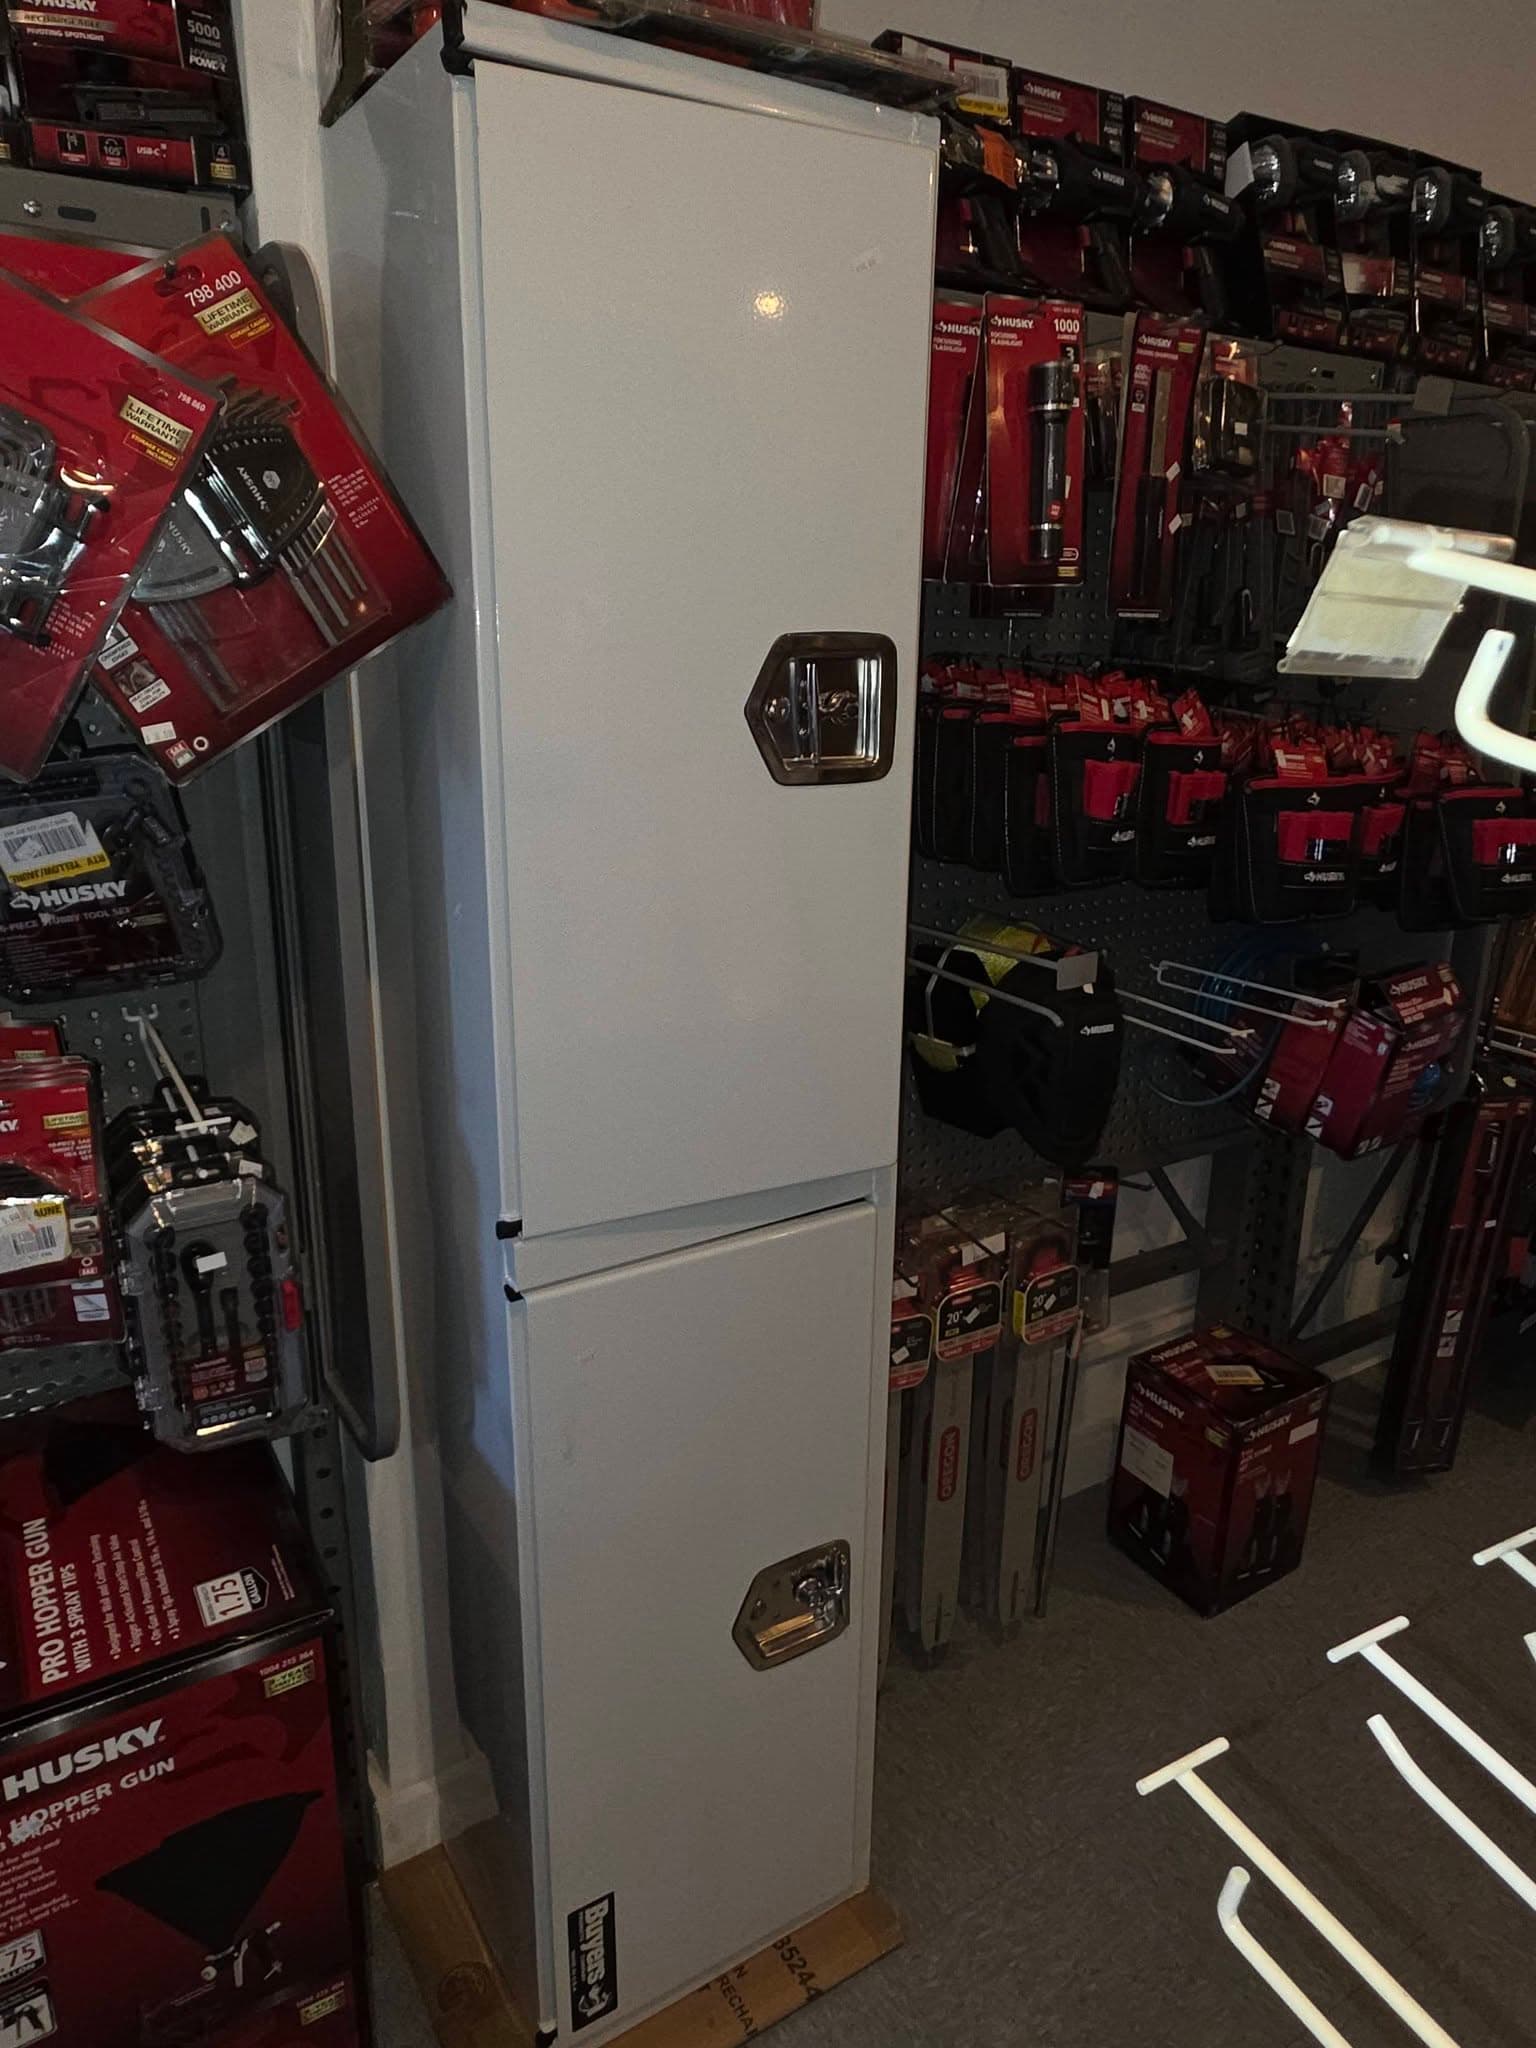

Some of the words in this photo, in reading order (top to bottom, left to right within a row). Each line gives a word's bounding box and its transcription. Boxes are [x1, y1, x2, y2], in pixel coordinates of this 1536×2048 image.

[187, 19, 221, 40] 5000
[1034, 84, 1062, 100] HUSKY
[136, 146, 161, 157] USB-C
[184, 284, 214, 307] 798
[215, 270, 241, 291] 400
[201, 294, 250, 324] LIFETIME
[207, 303, 253, 330] WARRANTY
[948, 322, 981, 336] HUSKY
[1001, 317, 1034, 329] HUSKY
[1054, 319, 1080, 333] 1000
[990, 338, 1023, 347] FLASHLIGHT
[1065, 347, 1074, 361] 3
[1148, 335, 1173, 348] HUSKY
[126, 410, 179, 444] WARRANTY
[128, 402, 184, 437] LIFETIME
[236, 466, 263, 501] HUSKY
[86, 854, 106, 867] RTV
[40, 880, 127, 906] HUSKY
[84, 910, 110, 921] TOOL
[1399, 976, 1430, 993] HUSKY
[1145, 1387, 1184, 1420] HUSKY
[1257, 1413, 1292, 1436] HUSKY
[22, 1517, 51, 1559] GUN
[60, 1563, 77, 1589] TIPS
[244, 1572, 262, 1605] GALLON
[28, 1559, 62, 1638] HOPPER
[64, 1590, 85, 1628] SPRAY
[211, 1579, 244, 1616] 1.75
[70, 1629, 87, 1640] 3
[38, 1638, 69, 1684] PRO
[72, 1638, 92, 1673] WITH
[2, 1719, 163, 1800] HUSKY
[10, 1783, 112, 1836] HOPPER
[120, 1757, 175, 1789] GUN
[68, 1804, 100, 1823] TIPS
[580, 1898, 609, 1985] Buyers
